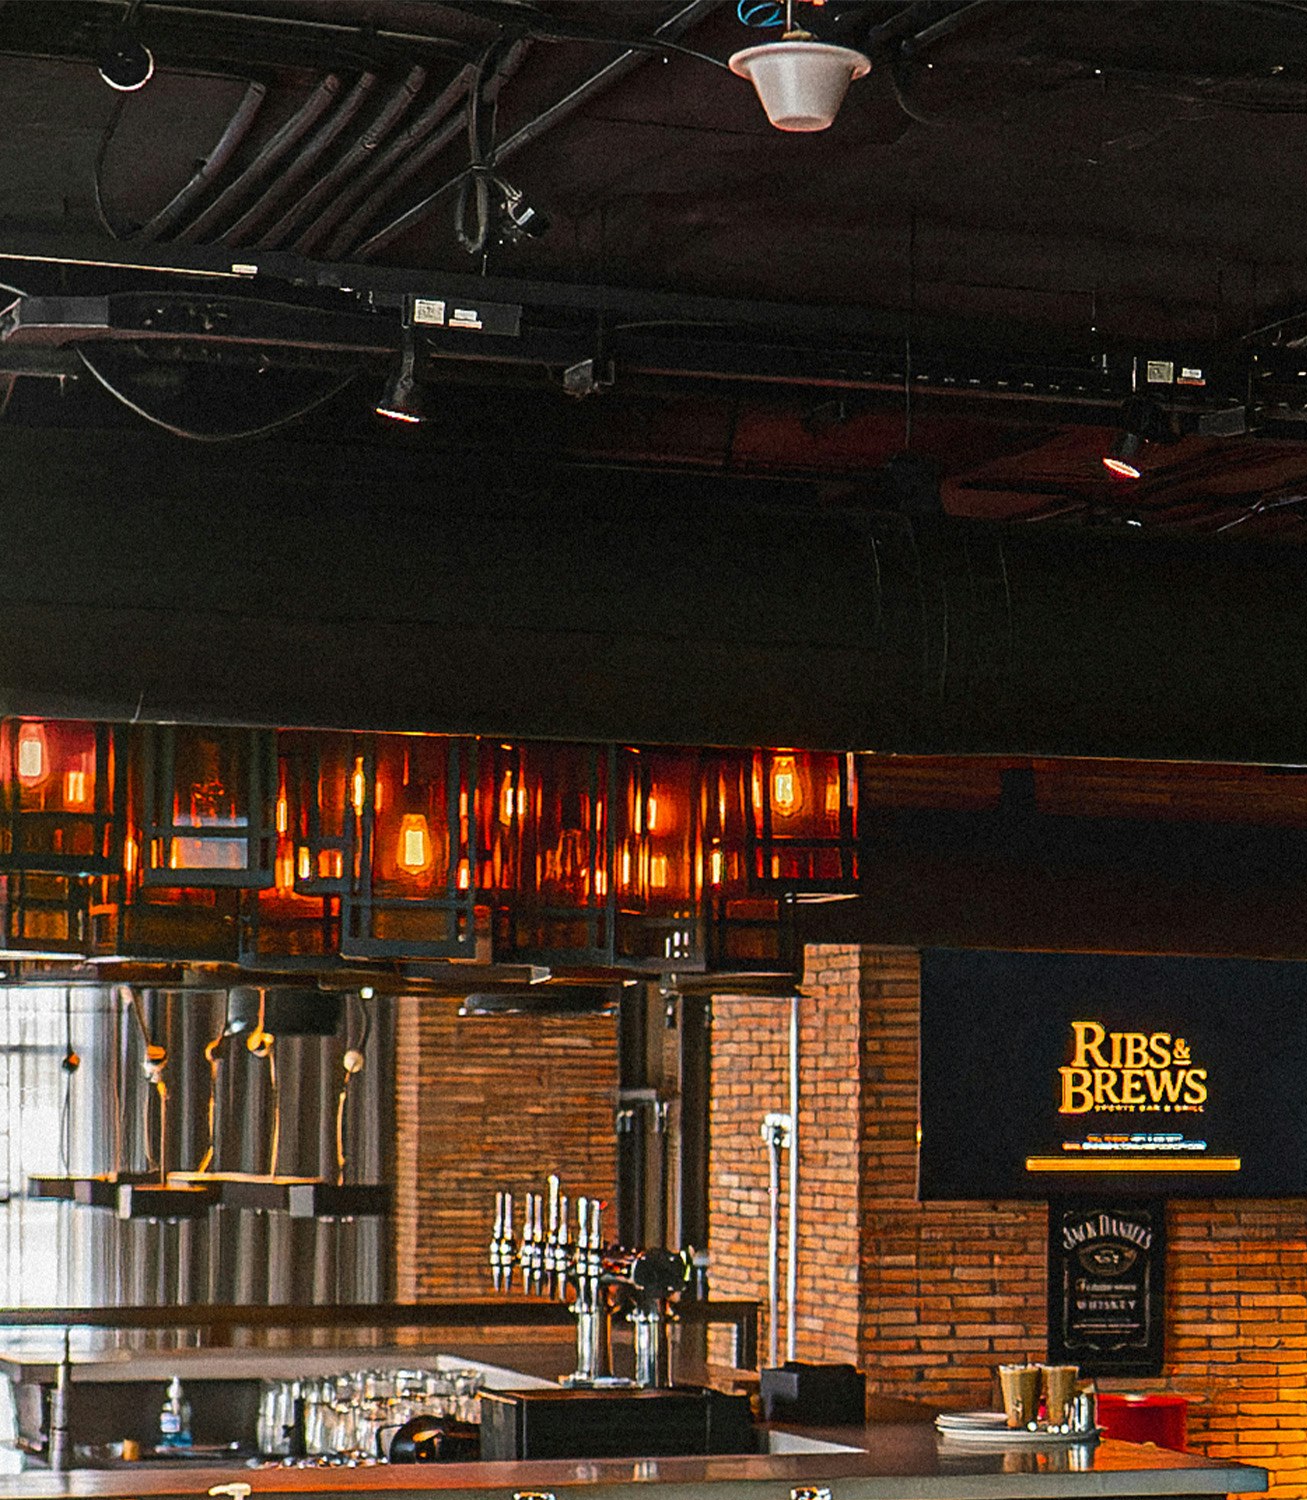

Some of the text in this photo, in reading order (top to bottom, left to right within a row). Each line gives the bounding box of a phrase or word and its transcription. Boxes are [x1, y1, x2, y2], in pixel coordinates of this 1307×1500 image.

[1071, 1021, 1191, 1069] RIBS &
[1058, 1067, 1207, 1114] BREWS
